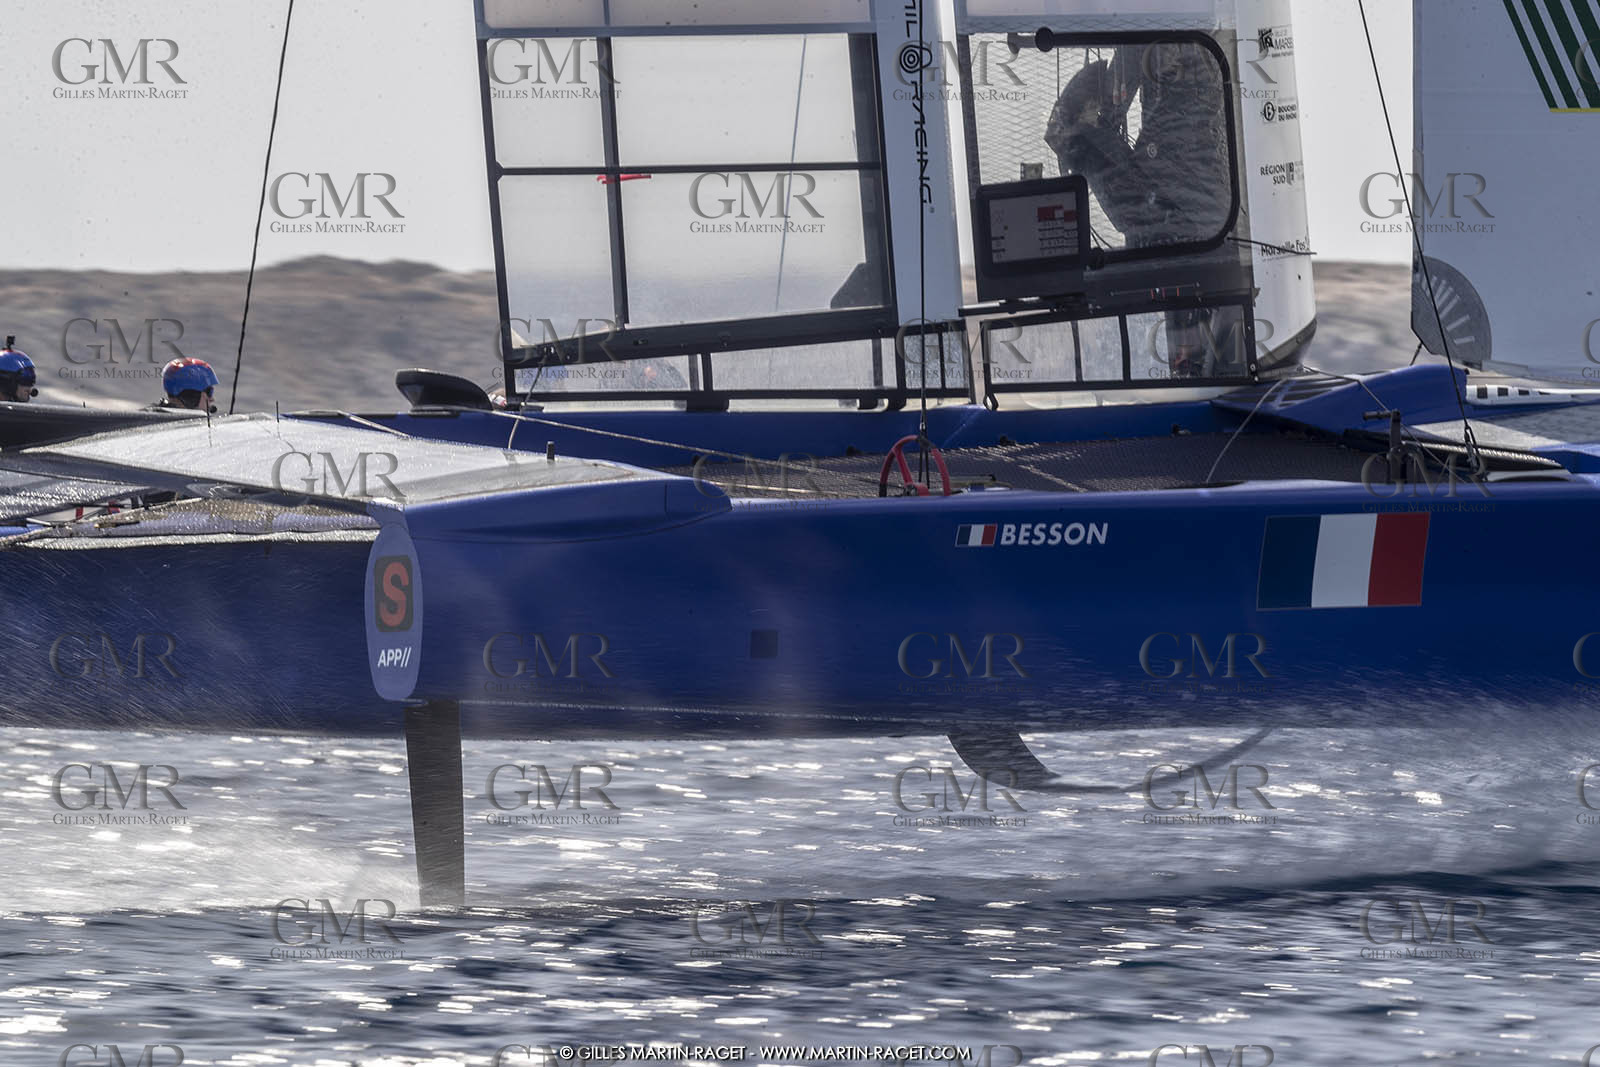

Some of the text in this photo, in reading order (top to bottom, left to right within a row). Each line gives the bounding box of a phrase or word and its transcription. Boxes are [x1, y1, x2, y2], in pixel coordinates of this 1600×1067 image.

[910, 80, 932, 204] RACING
[1273, 175, 1286, 185] SUD
[1000, 523, 1108, 545] BESSON
[379, 561, 409, 627] S
